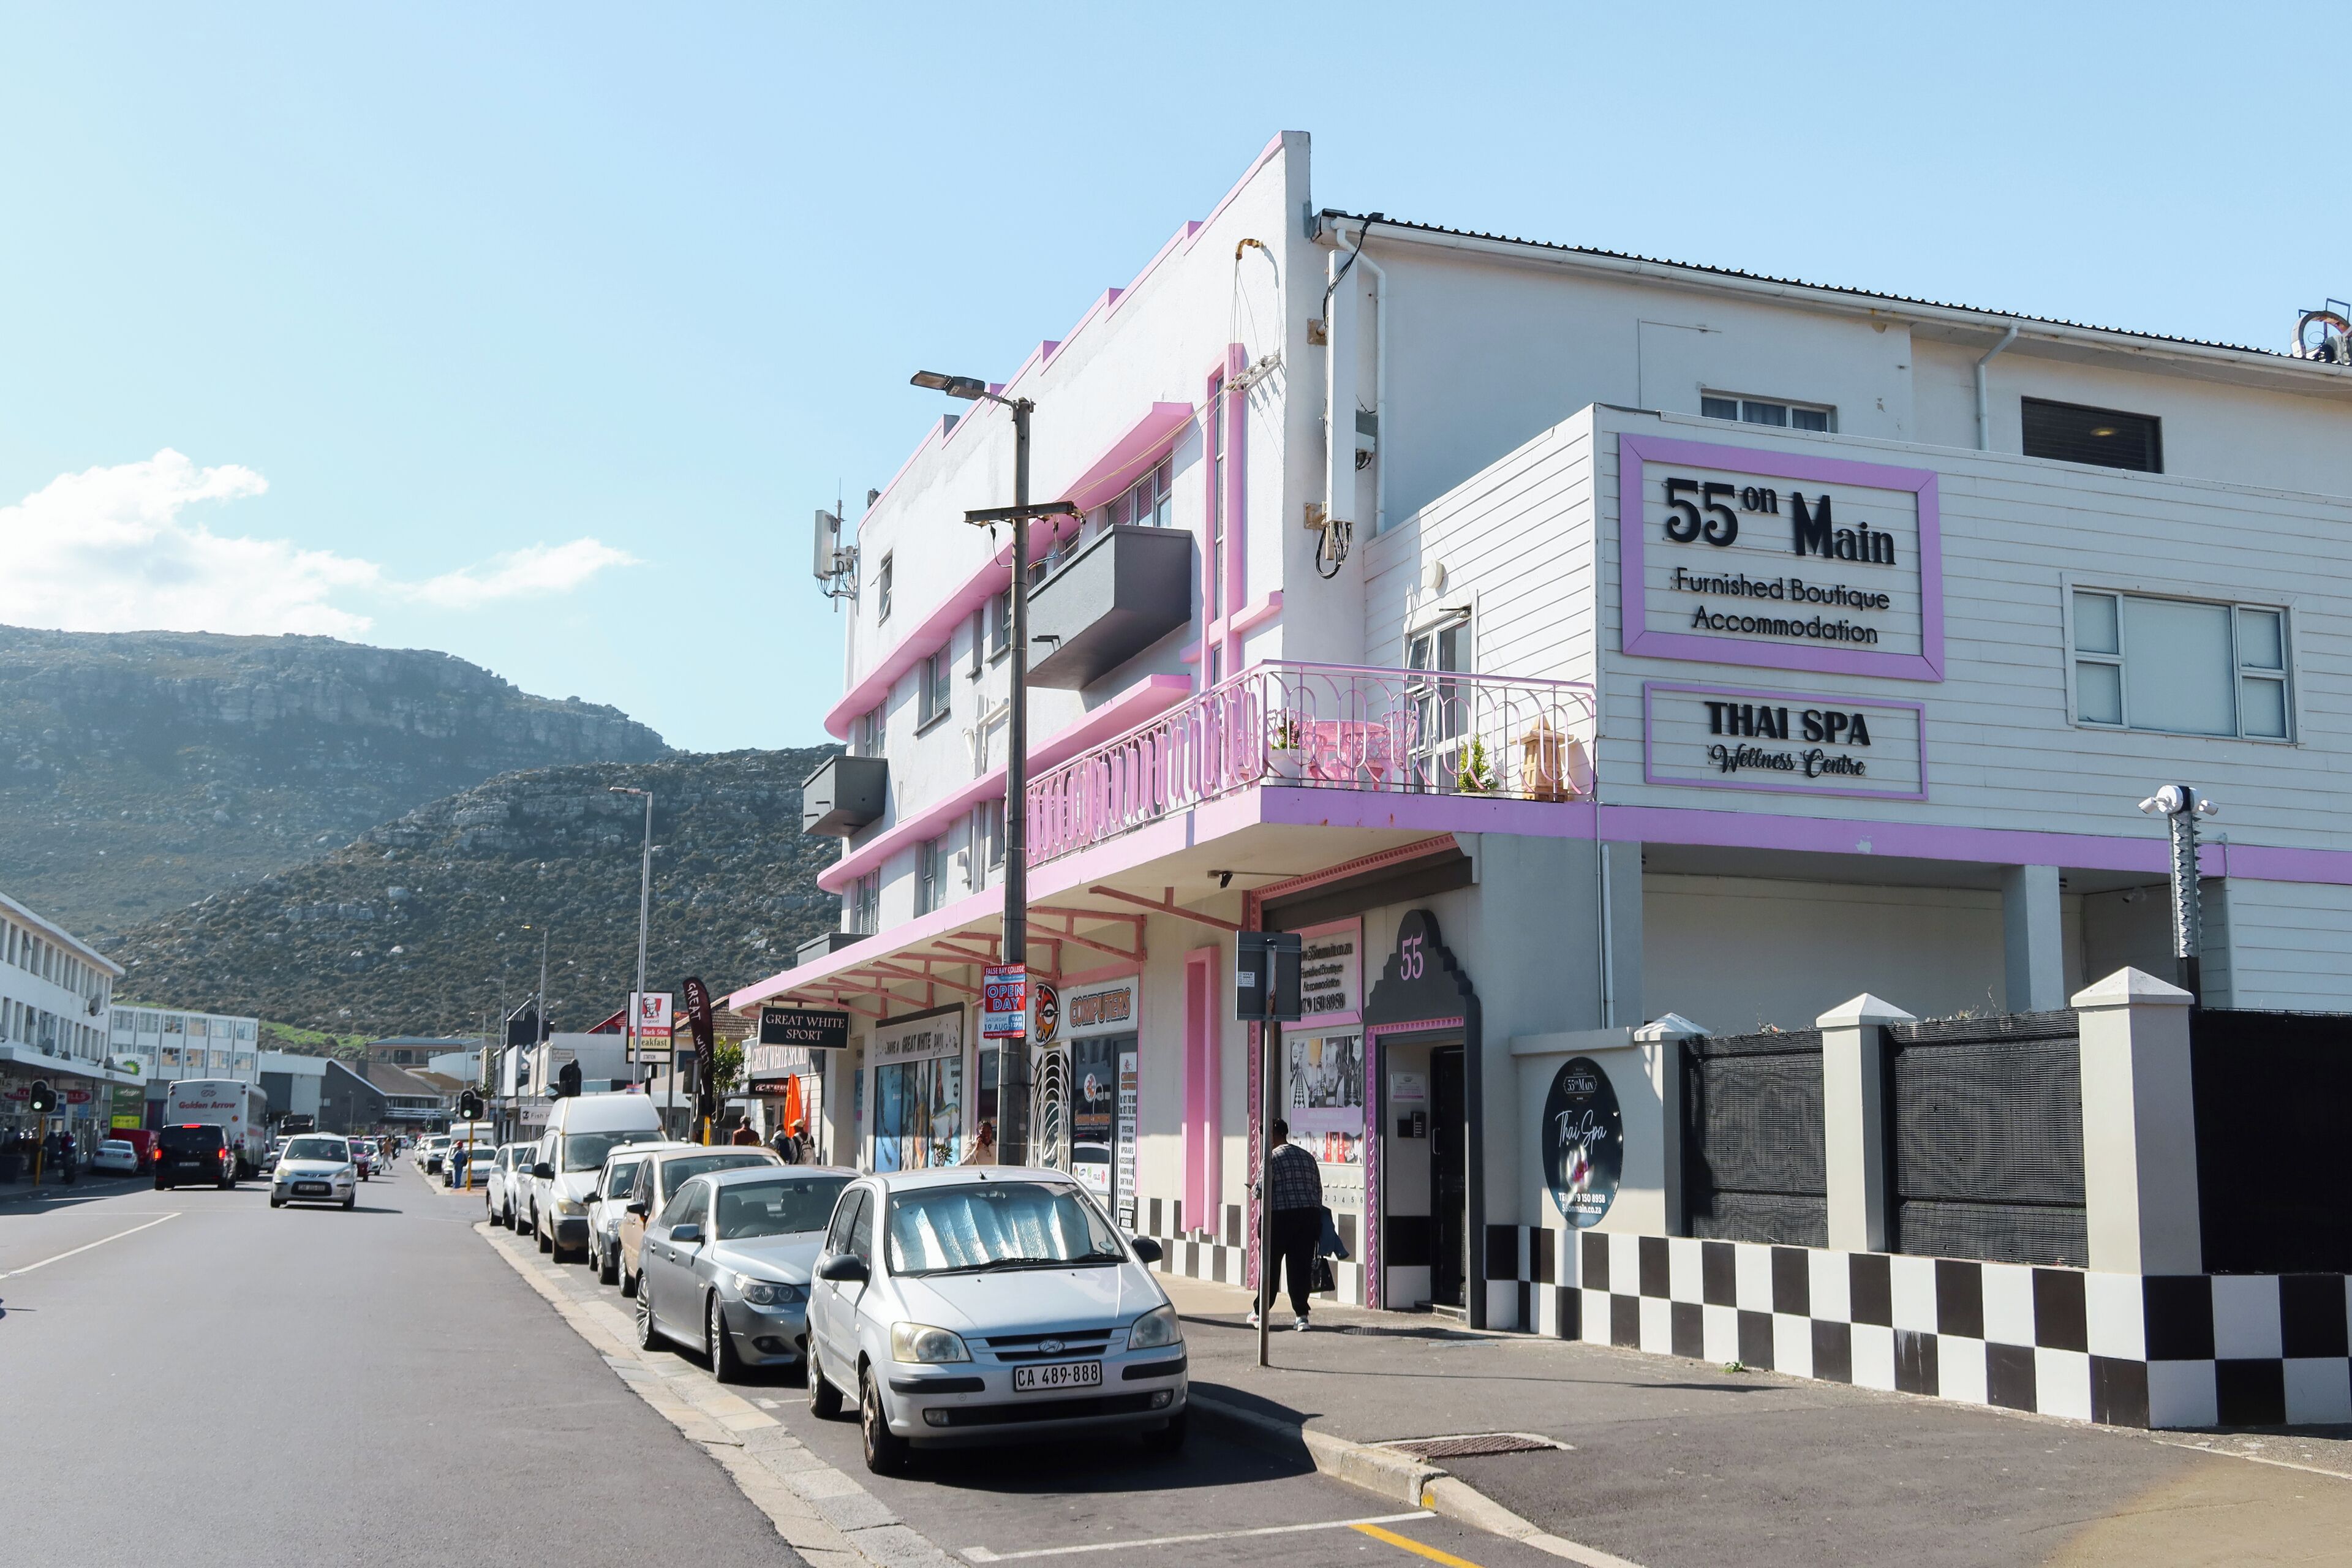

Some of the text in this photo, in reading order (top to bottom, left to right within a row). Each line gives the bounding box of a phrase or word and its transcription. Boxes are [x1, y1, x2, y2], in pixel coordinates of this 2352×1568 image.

[1667, 477, 1896, 566] 55 on Main
[1676, 567, 1890, 611] Furnished Boutique
[1692, 606, 1879, 644] Accommodation
[1705, 701, 1872, 746] THAI SPA
[1709, 744, 1866, 778] Wellness Centre
[1302, 942, 1352, 962] w.55onmain.co.za
[1400, 932, 1423, 981] 55
[1008, 965, 1025, 974] COLLEGE
[1322, 963, 1343, 975] Boutique
[987, 984, 1024, 998] OPEN
[1303, 978, 1340, 992] Accommodation
[687, 982, 701, 1020] GREAT
[993, 998, 1020, 1011] DAY
[1069, 987, 1131, 1028] COMPUTERS
[1302, 992, 1346, 1014] 79 150 8958
[766, 1014, 845, 1028] GREAT WHITE
[786, 1029, 823, 1040] SPORT
[902, 1035, 917, 1054] GREAT
[918, 1031, 932, 1051] WHITE
[752, 1046, 807, 1072] GREAT WHITE SPORT
[1567, 1079, 1575, 1091] 55
[1555, 1109, 1607, 1155] Thai Spa
[1120, 1178, 1134, 1186] SOFTWARE
[1562, 1203, 1602, 1215] 55onmain.co.za
[1581, 1193, 1591, 1203] 150
[1592, 1194, 1605, 1204] 8958
[1017, 1365, 1098, 1387] CA 489-888
